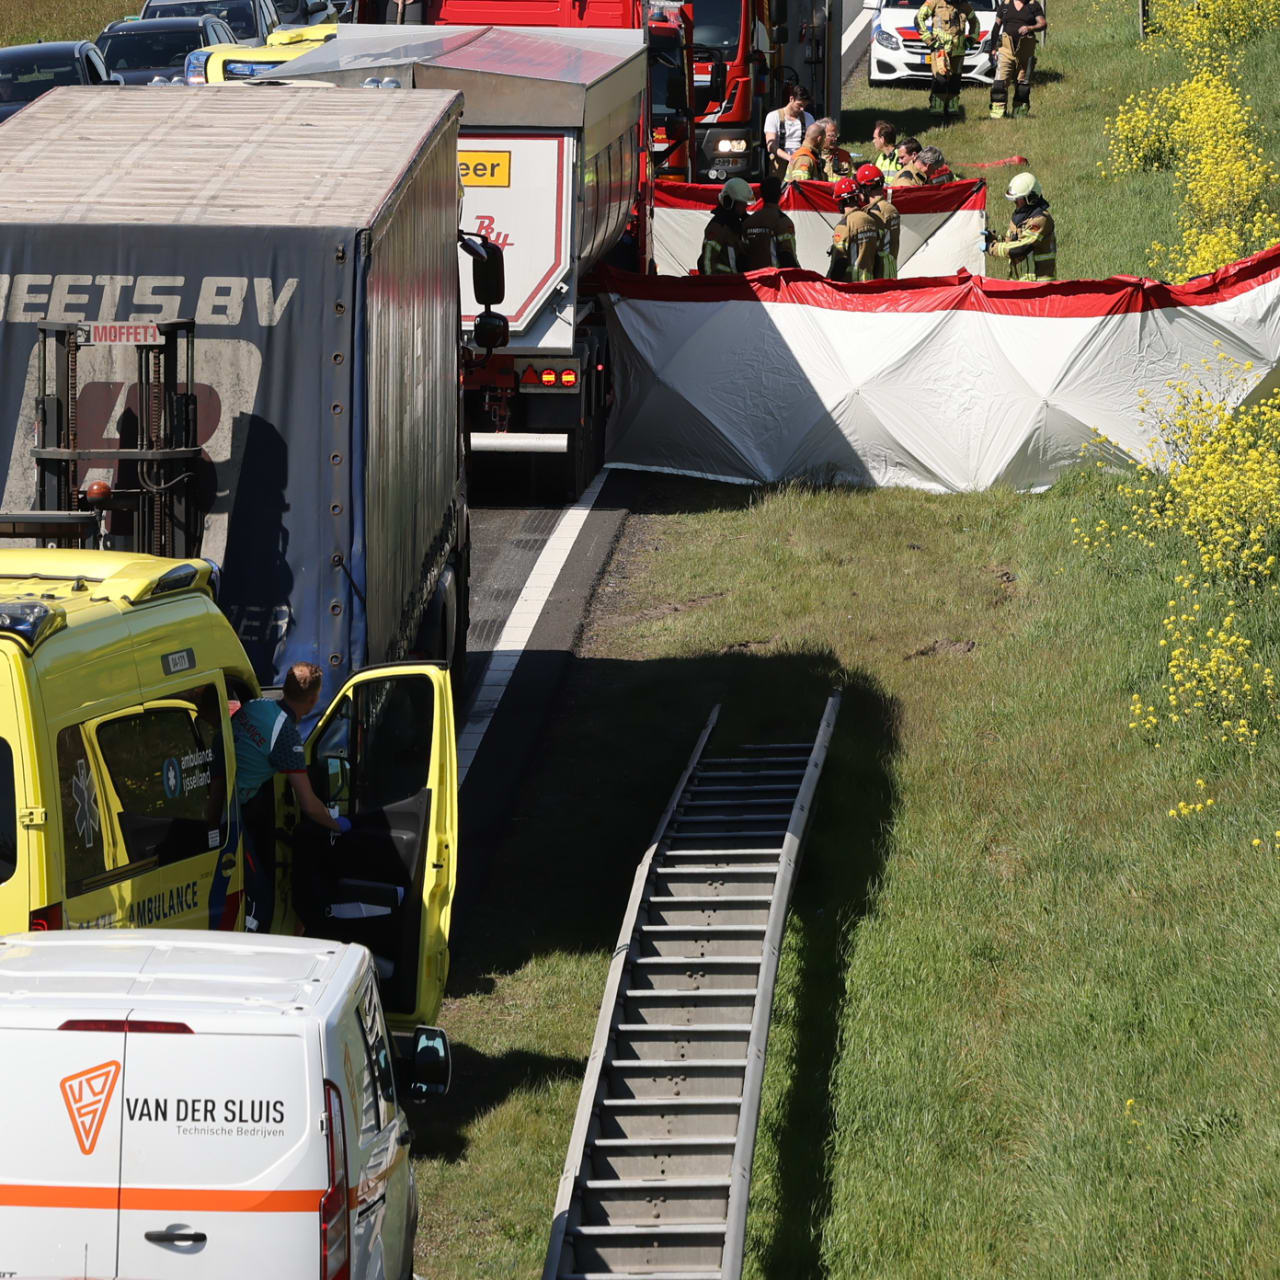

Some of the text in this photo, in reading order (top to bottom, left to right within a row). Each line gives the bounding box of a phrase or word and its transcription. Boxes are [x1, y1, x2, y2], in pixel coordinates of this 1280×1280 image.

[195, 277, 299, 326] BV
[93, 325, 158, 343] MOFFETT
[181, 748, 213, 769] ambulance
[182, 767, 211, 797] ijsselland
[129, 881, 198, 928] AMBULANCE
[126, 1098, 285, 1124] VAN DER SLUIS
[176, 1125, 284, 1138] Technische Bedrijven
